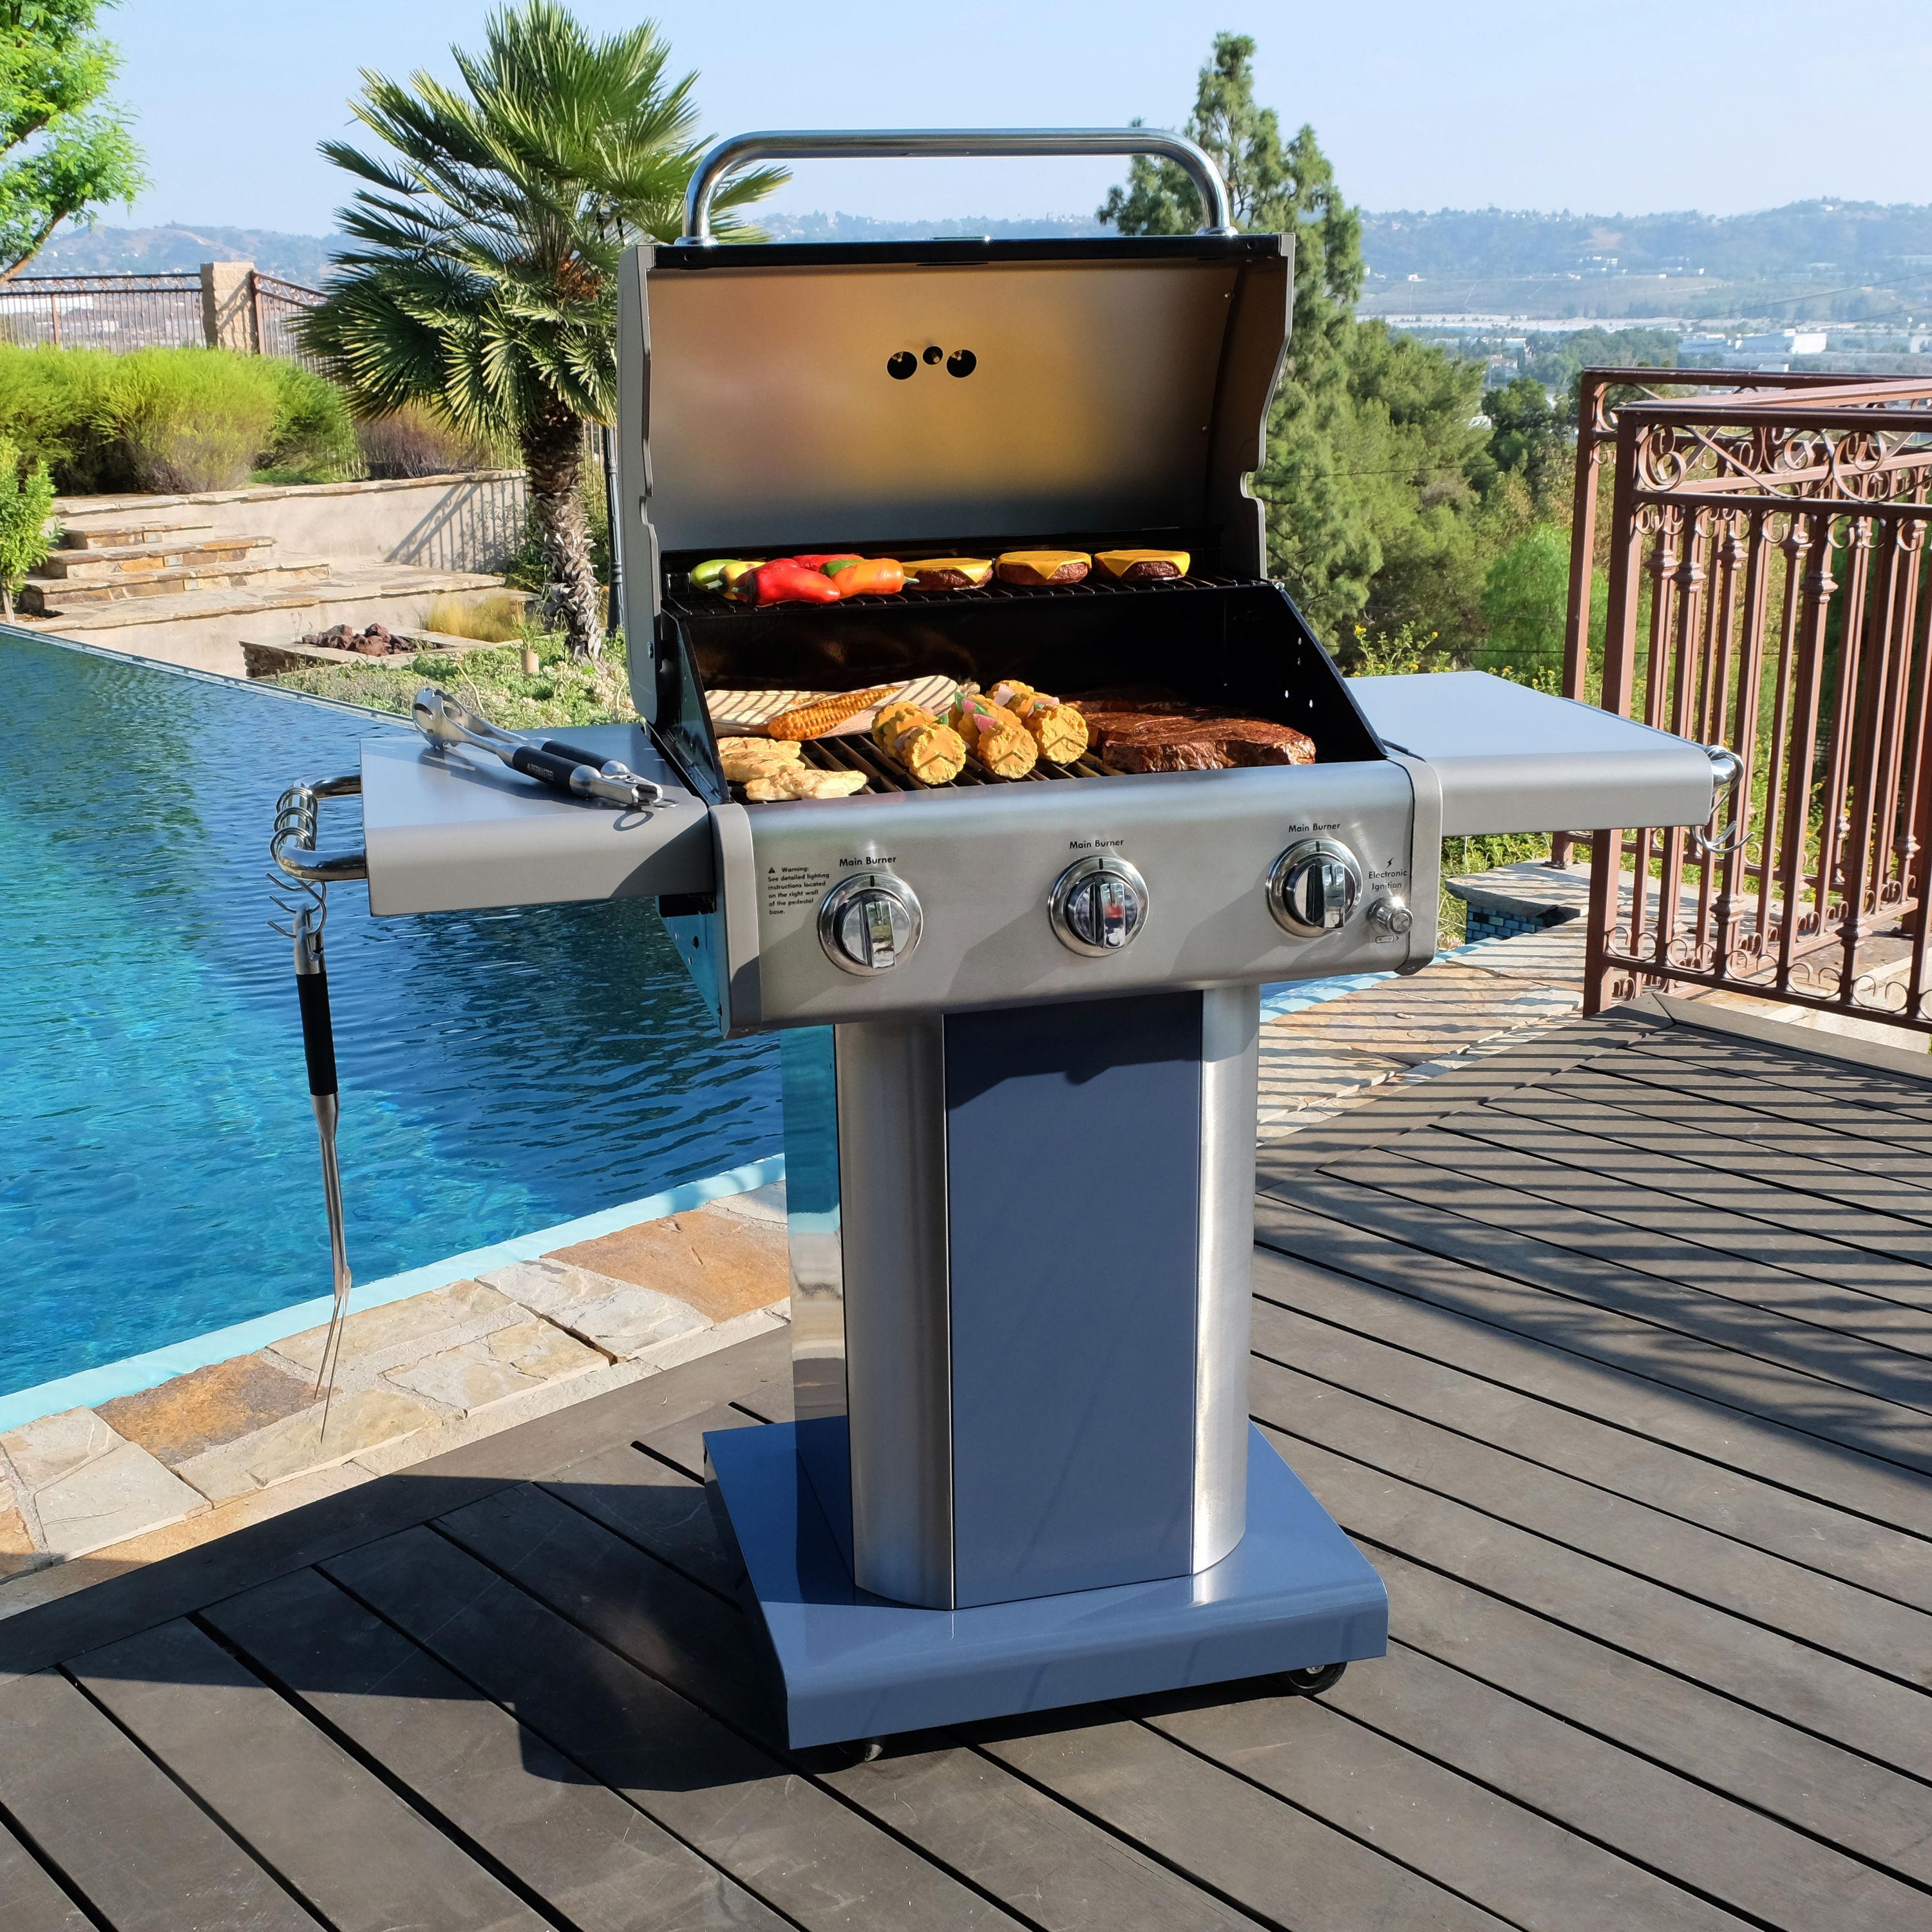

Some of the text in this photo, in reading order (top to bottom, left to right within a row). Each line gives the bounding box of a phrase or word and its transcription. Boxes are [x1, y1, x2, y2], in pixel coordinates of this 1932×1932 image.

[1289, 824, 1310, 833] Main
[1070, 839, 1124, 849] Main Burner
[839, 857, 896, 867] Main Burner
[1368, 869, 1407, 878] Electronic
[1372, 881, 1402, 892] Ignition
[788, 898, 814, 906] pedestal
